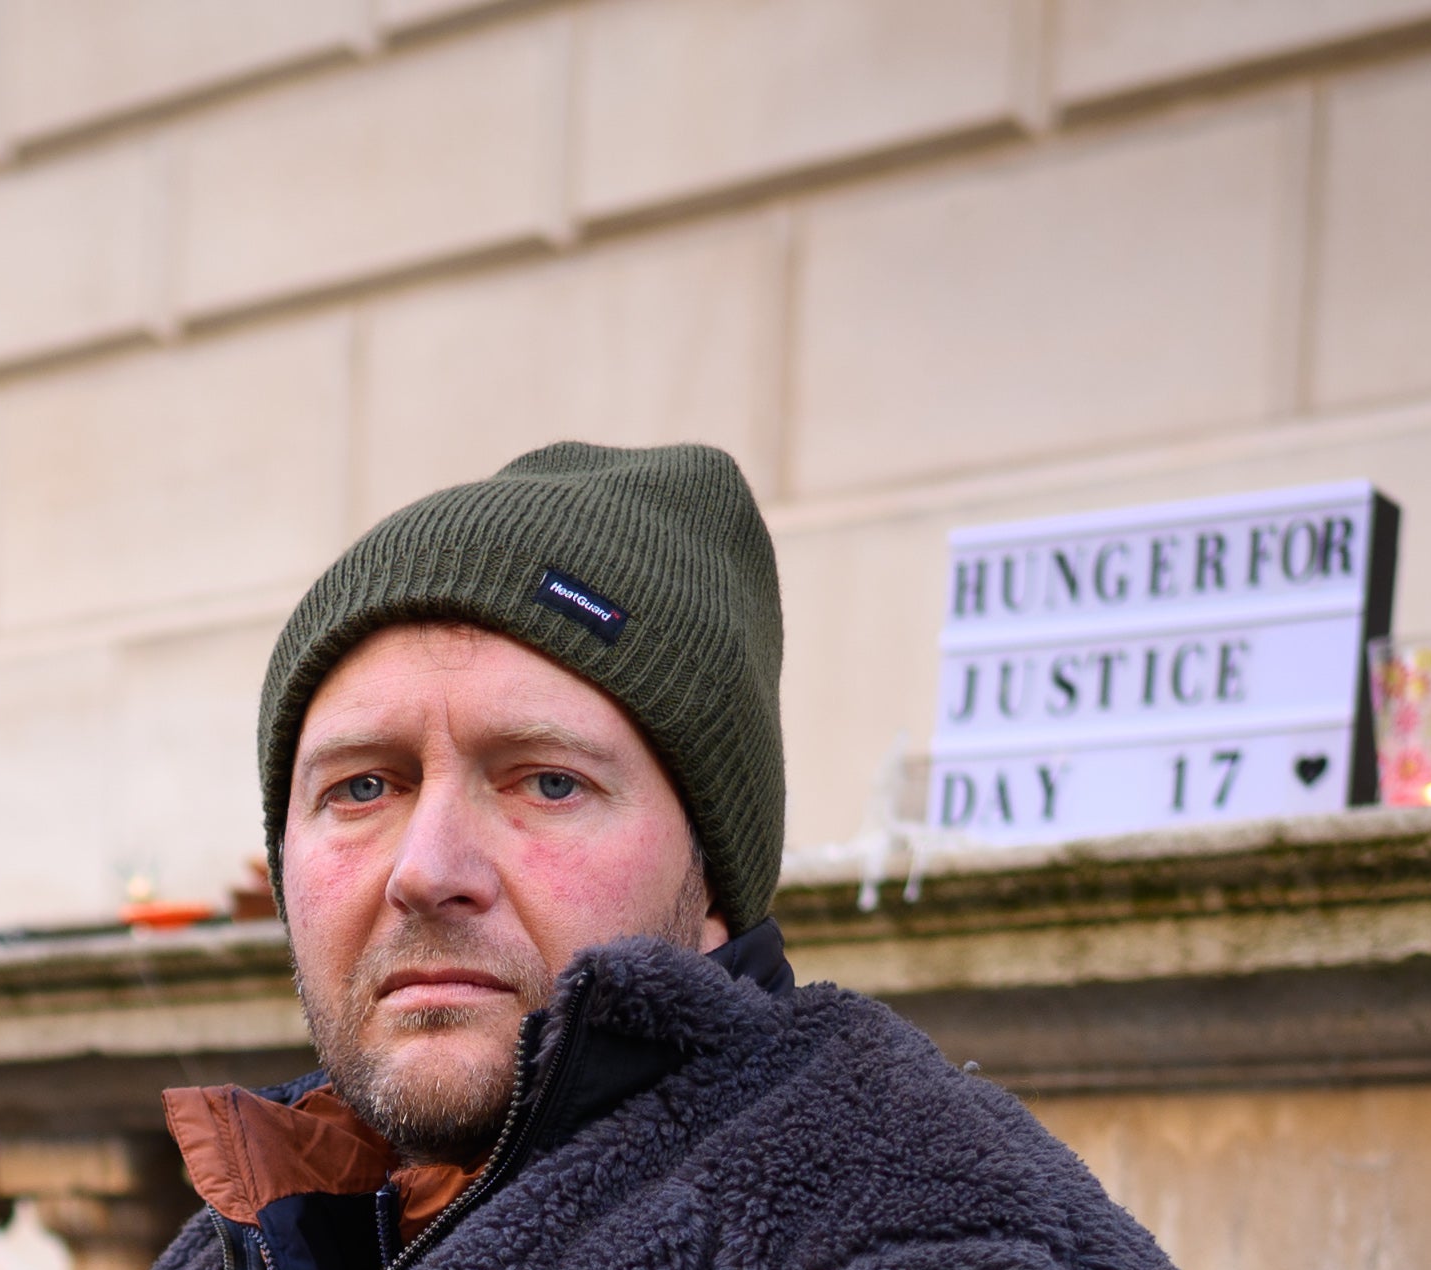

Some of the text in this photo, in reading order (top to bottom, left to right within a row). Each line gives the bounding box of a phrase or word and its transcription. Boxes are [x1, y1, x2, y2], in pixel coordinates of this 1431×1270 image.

[950, 512, 1358, 621] HUNGER FOR
[948, 639, 1251, 724] JUSTICE
[940, 747, 1245, 830] DAY 17
